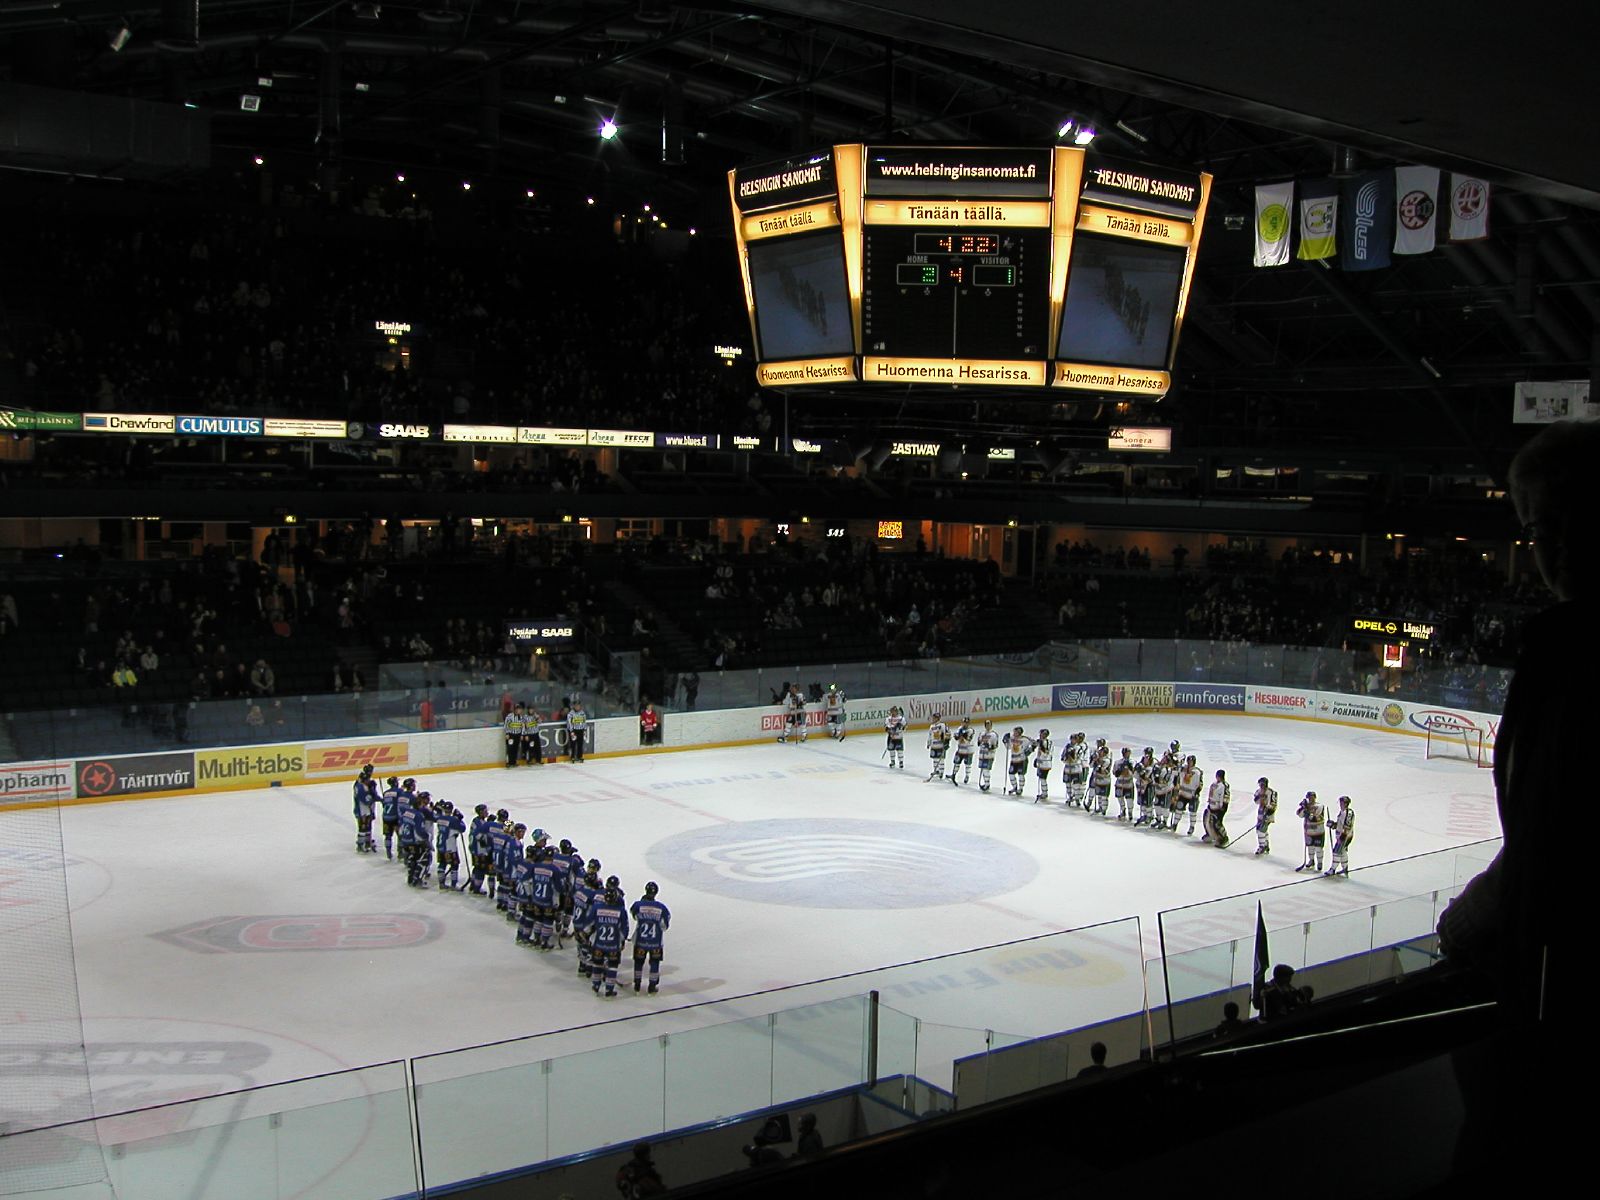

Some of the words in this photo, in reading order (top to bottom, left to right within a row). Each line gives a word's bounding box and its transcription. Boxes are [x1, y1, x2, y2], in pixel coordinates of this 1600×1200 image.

[880, 162, 1037, 180] www.helsinginsanomat.fi
[740, 174, 781, 197] HELSINGIN
[782, 166, 822, 187] SANOMAT
[1096, 169, 1149, 193] HELSINGIN
[1150, 179, 1195, 202] SANOMAT
[908, 206, 959, 220] Tänään
[964, 206, 1007, 221] täällä.
[759, 217, 788, 233] Tänään
[790, 211, 816, 228] täällä.
[1106, 215, 1141, 233] Tänään
[1143, 221, 1170, 238] täällä.
[907, 255, 929, 264] HOME
[980, 256, 1010, 265] VISITOR
[761, 368, 804, 381] Huomenna
[806, 364, 850, 379] Hesarissa.
[877, 363, 954, 378] Huomenna
[958, 365, 1031, 380] Hesarissa.
[1060, 369, 1115, 386] Huomenna
[1116, 373, 1165, 390] Hesarissa.
[110, 417, 174, 430] Crawford
[179, 418, 260, 434] CUMULUS
[380, 424, 430, 438] SAAB
[890, 442, 941, 456] EASTWAY
[541, 628, 573, 637] SAAB
[1354, 620, 1385, 632] OPEL
[1130, 685, 1173, 697] VARAMIES
[984, 695, 1030, 712] PRISMA
[1133, 696, 1170, 707] PALVELU
[321, 747, 396, 769] DHL
[199, 754, 304, 779] Multi-tabs
[119, 770, 191, 789] TÄHTITYÖT
[534, 883, 548, 898] 21
[599, 926, 615, 941] 22
[640, 923, 657, 938] 24
